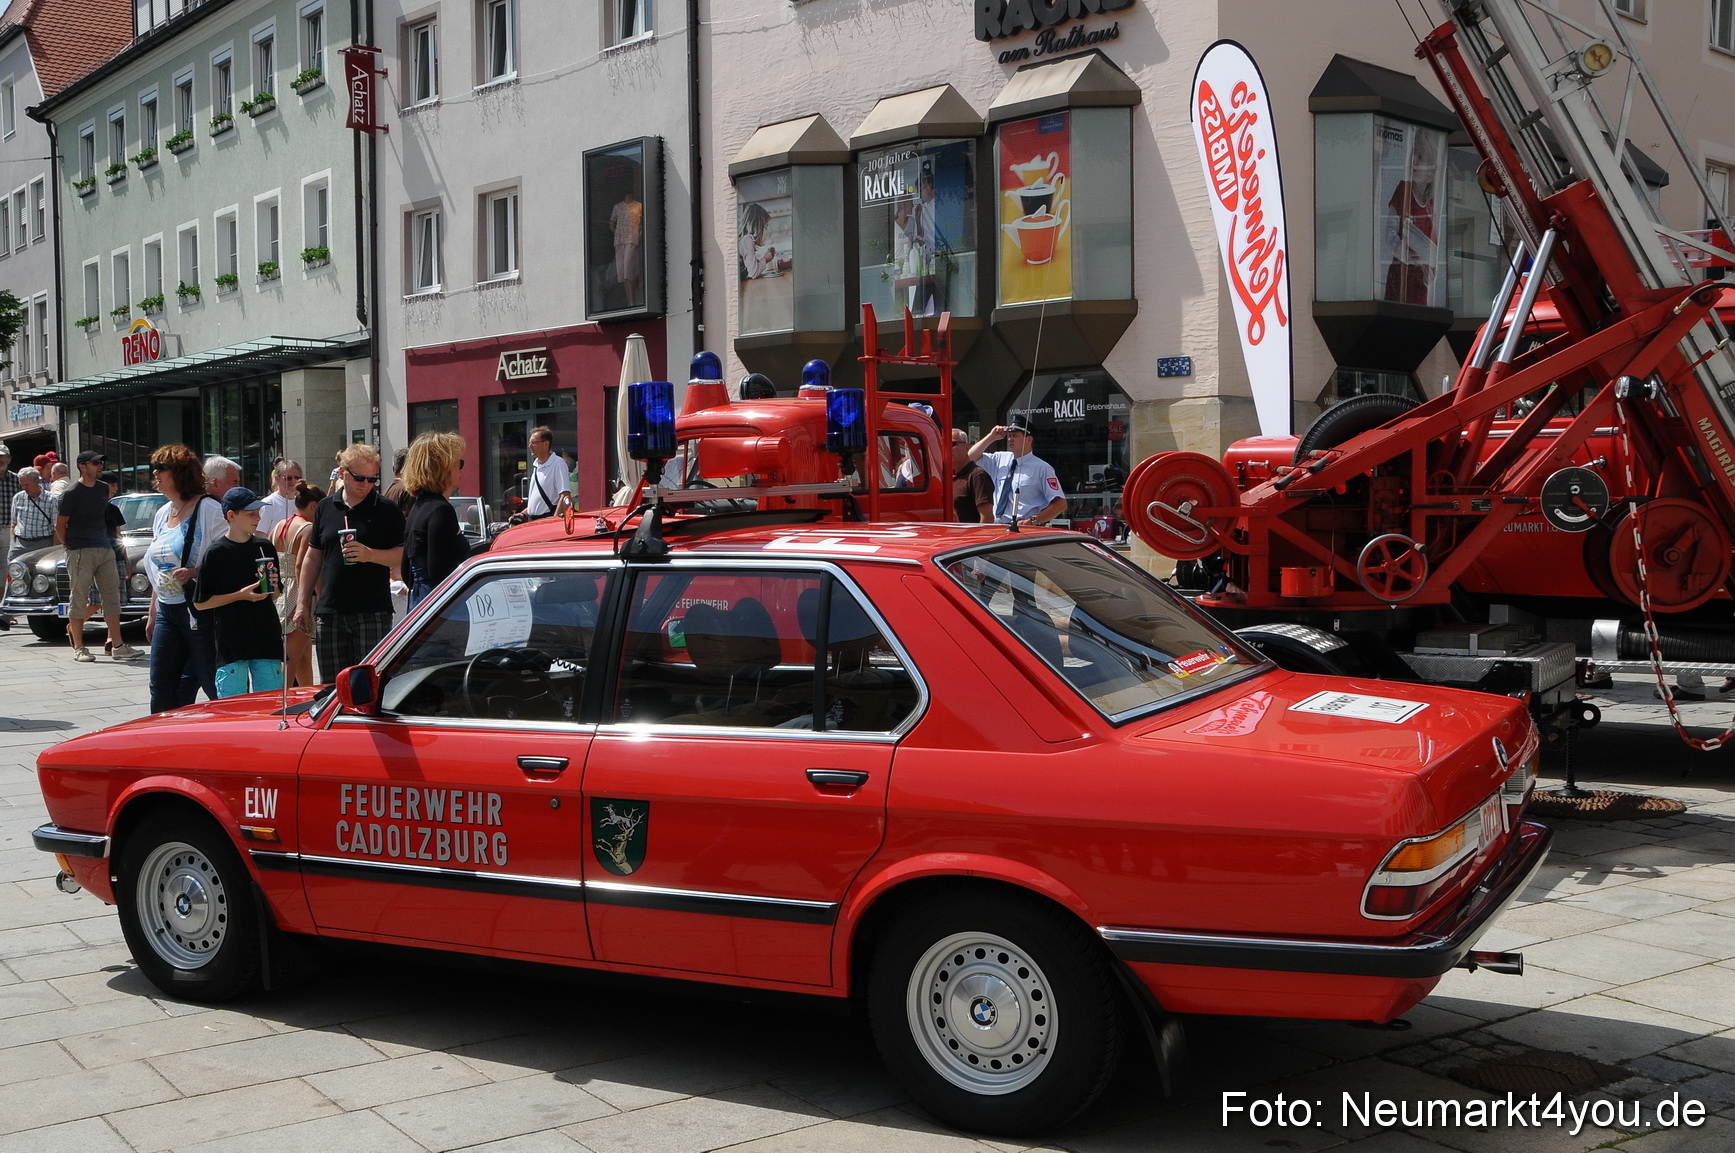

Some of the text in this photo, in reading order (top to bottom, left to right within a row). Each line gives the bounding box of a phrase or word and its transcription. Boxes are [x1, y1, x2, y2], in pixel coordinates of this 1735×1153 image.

[998, 22, 1121, 64] am Rathaus
[351, 63, 369, 125] Achatz
[868, 150, 911, 172] 100 Jahre
[864, 169, 905, 201] RACKL
[121, 328, 161, 367] RENO
[495, 351, 547, 381] Achatz
[1054, 399, 1086, 418] RACKL
[475, 593, 495, 618] 08
[244, 787, 279, 819] ELW
[340, 783, 503, 827] FEUERWEHR
[335, 819, 509, 867] CADOLZBURG
